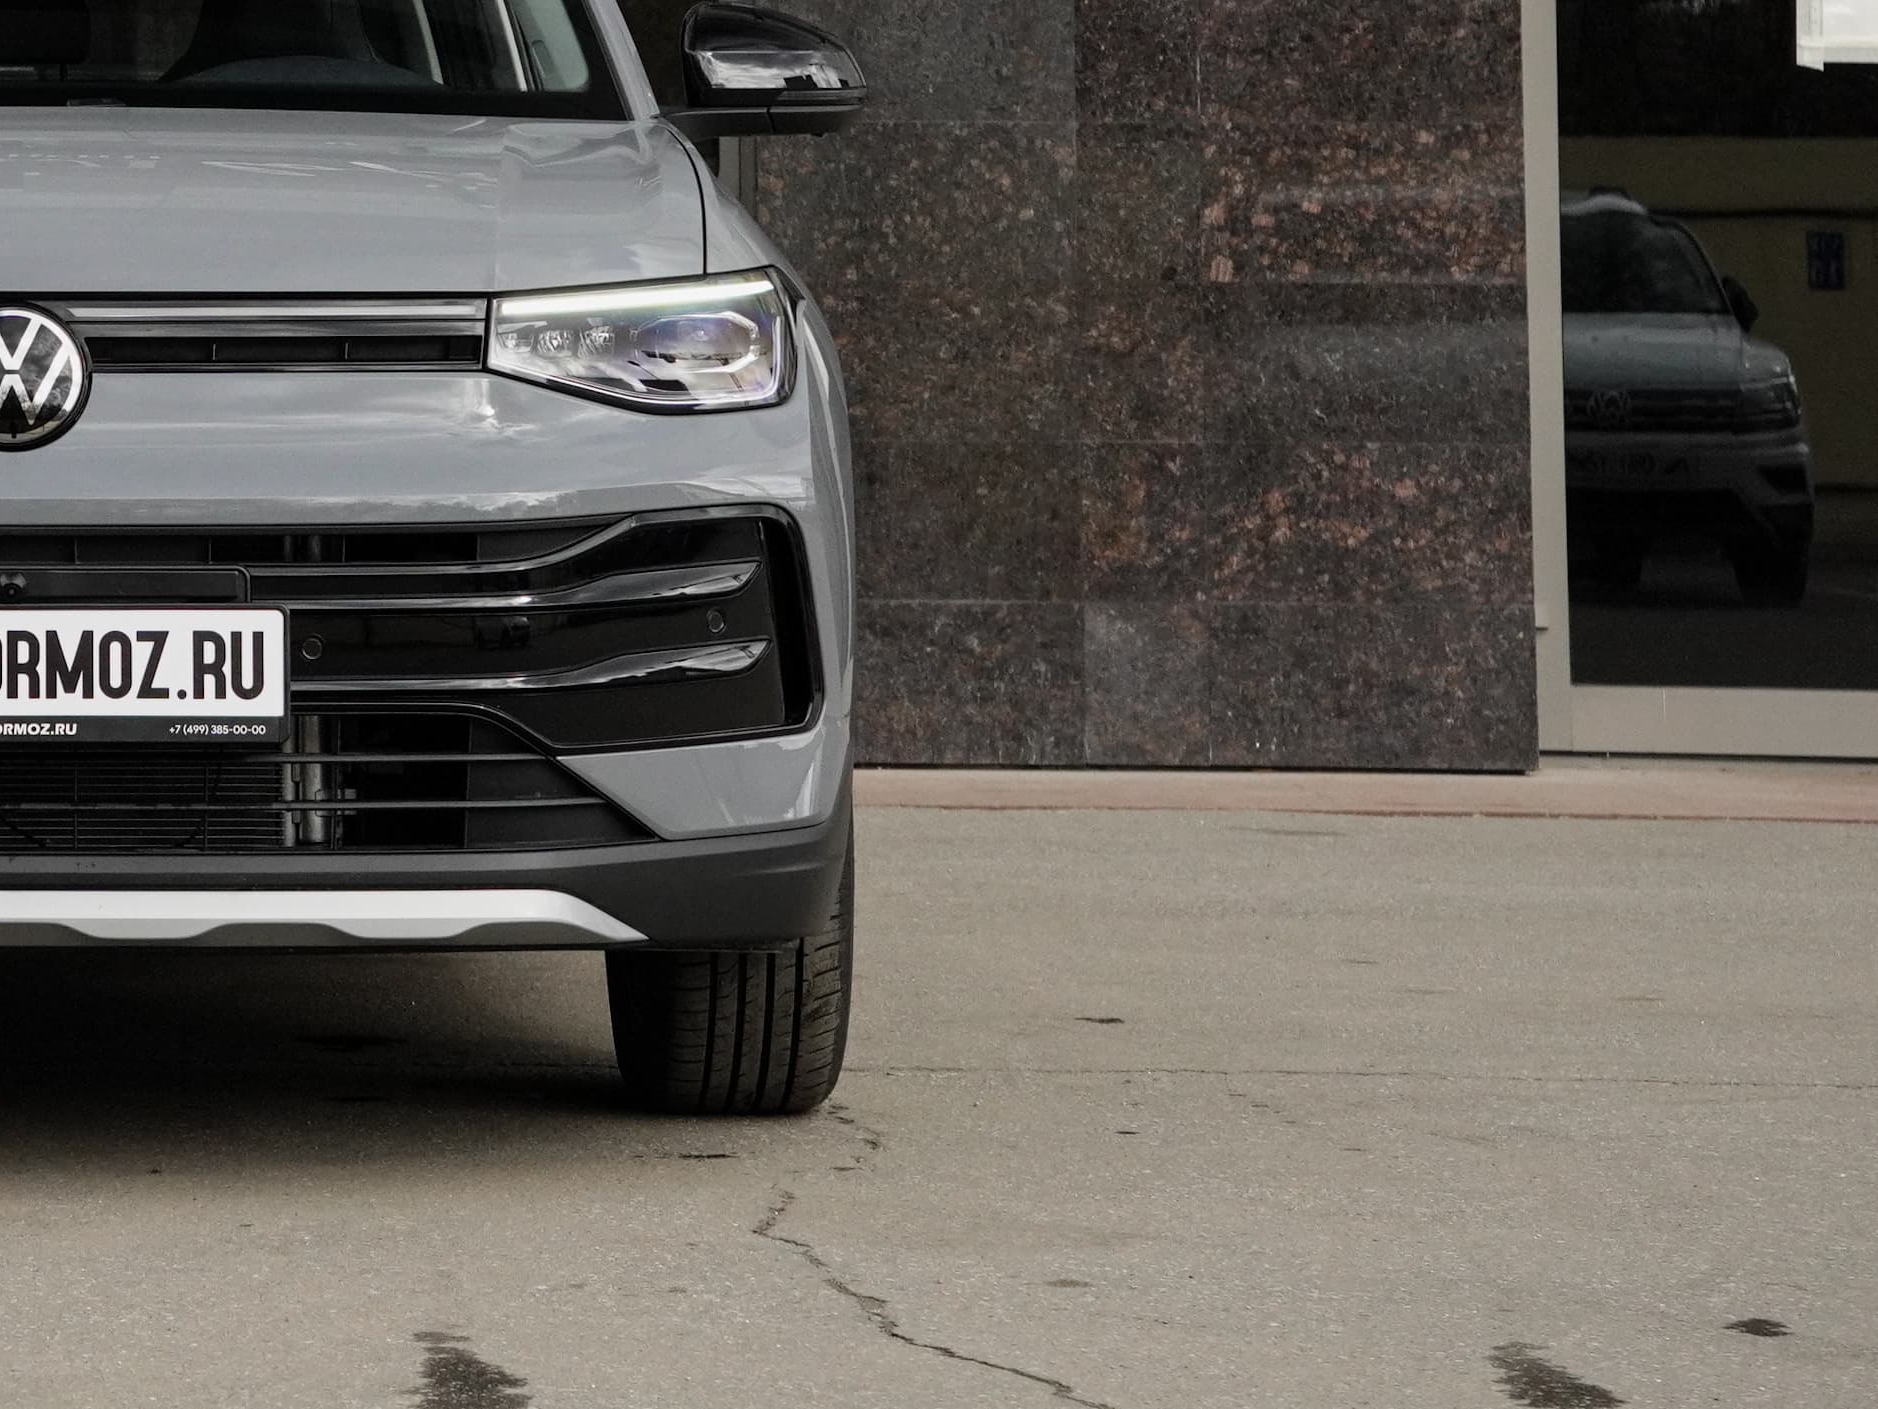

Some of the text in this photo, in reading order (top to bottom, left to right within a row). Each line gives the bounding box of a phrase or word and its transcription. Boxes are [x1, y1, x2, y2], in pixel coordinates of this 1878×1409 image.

[169, 723, 266, 735] +7 (499) 385-00-00
